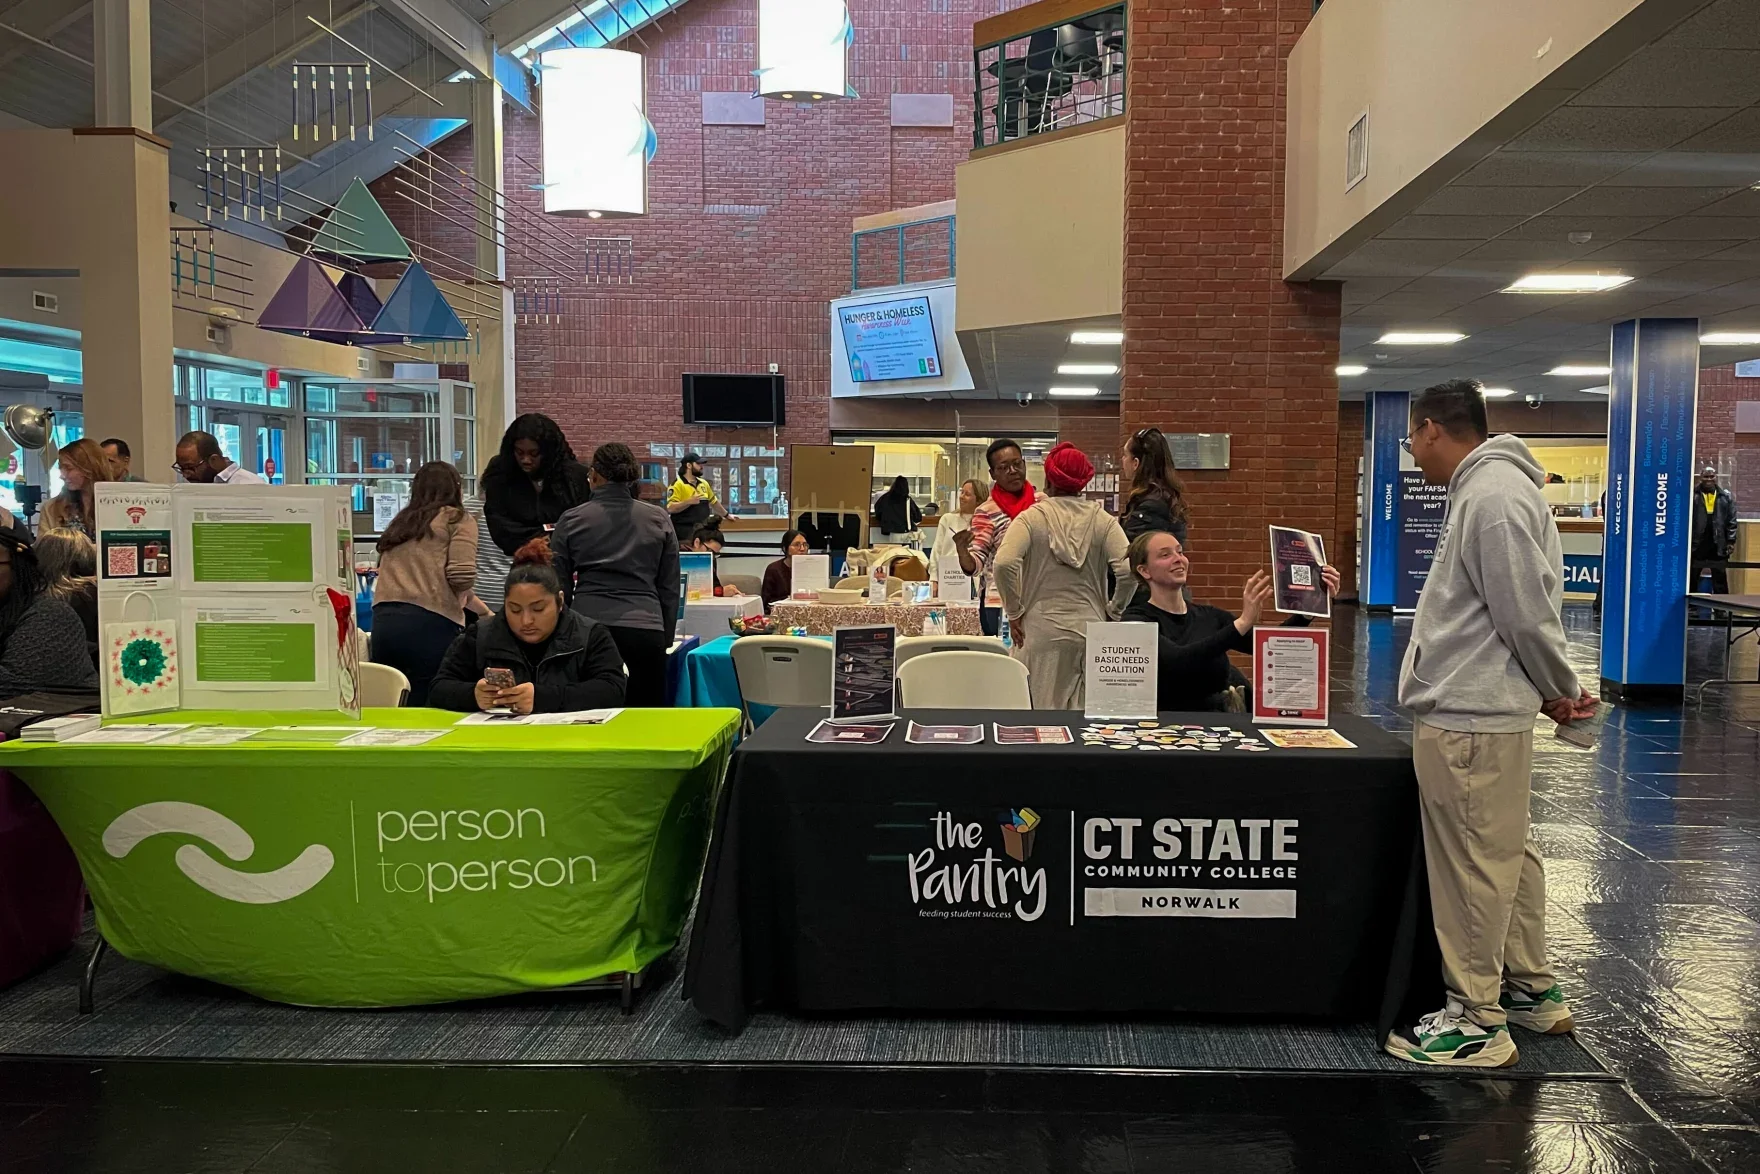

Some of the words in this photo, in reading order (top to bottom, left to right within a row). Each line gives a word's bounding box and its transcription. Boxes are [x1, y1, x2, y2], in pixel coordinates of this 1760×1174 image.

[844, 312, 875, 324] HUNGER
[876, 311, 883, 320] &
[883, 305, 925, 319] HOMELESS
[1643, 420, 1653, 467] Bienvenido
[1385, 483, 1393, 521] WELCOME
[1615, 473, 1623, 536] WELCOME
[1654, 473, 1668, 537] WELCOME
[1099, 665, 1145, 674] COALITION
[1101, 646, 1141, 655] STUDENT
[1122, 656, 1150, 664] NEEDS
[377, 807, 546, 853] person
[929, 811, 983, 851] the
[1083, 817, 1142, 860] CT
[1152, 818, 1299, 861] STATE
[377, 855, 597, 903] toperson
[908, 847, 1047, 922] Pantry
[1084, 865, 1202, 878] COMMUNITY
[1210, 867, 1297, 879] COLLEGE
[918, 909, 949, 919] feeding
[950, 910, 981, 918] student
[1141, 896, 1240, 909] NORWALK
